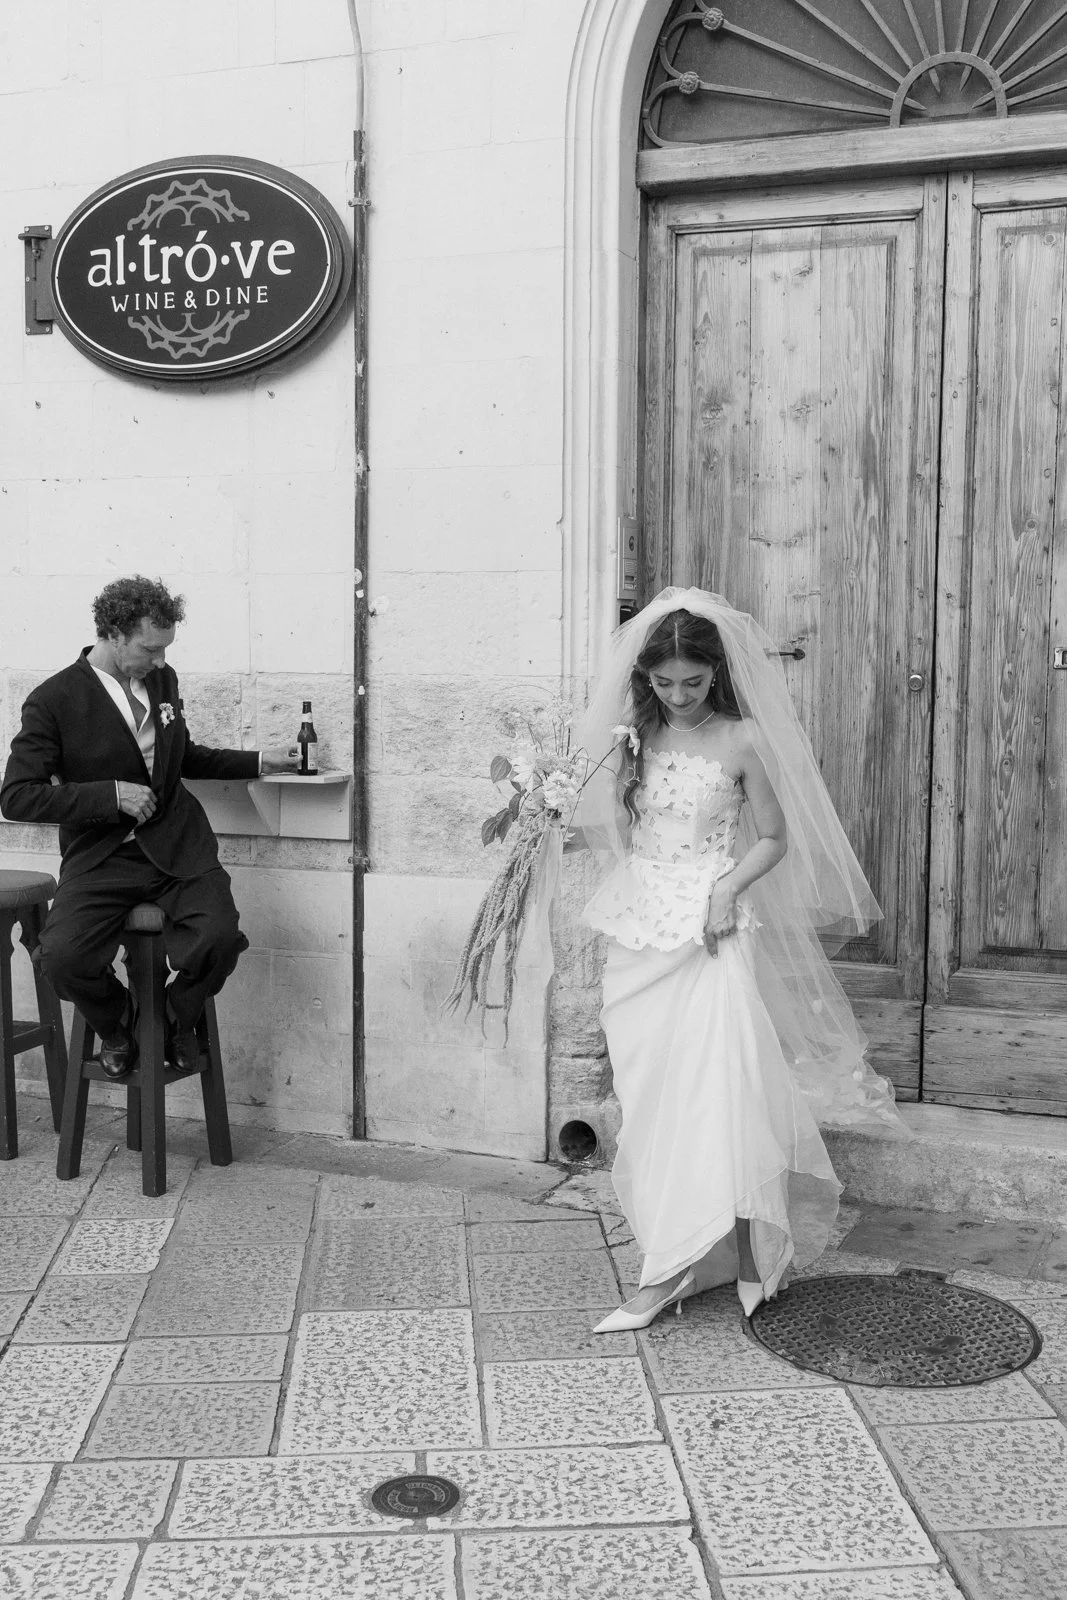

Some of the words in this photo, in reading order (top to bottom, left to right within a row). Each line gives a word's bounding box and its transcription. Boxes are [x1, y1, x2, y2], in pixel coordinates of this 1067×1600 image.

[111, 291, 175, 313] WINE
[184, 290, 197, 309] &
[206, 285, 268, 307] DINE
